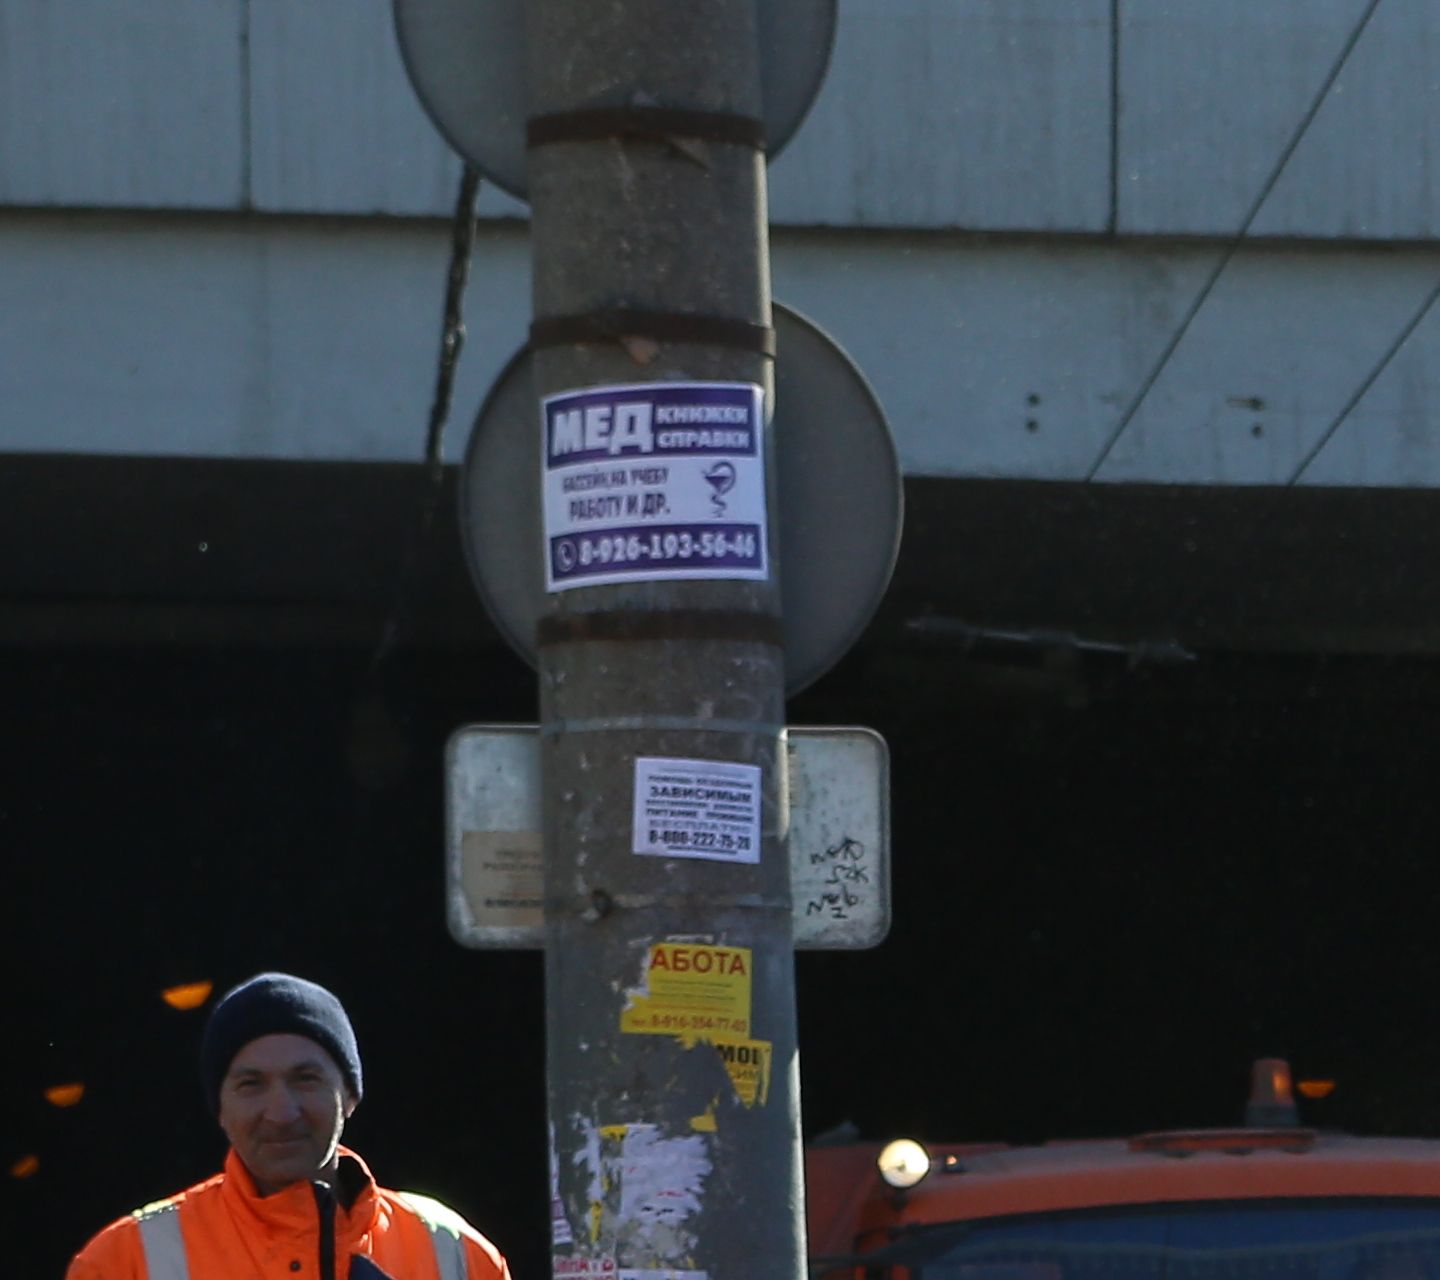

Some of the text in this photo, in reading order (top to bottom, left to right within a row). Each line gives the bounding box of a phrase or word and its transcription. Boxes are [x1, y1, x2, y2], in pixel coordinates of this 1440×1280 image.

[553, 403, 654, 456] МЕД
[658, 431, 750, 449] СПРАВКИ
[570, 496, 622, 520] РАБОТУ
[650, 947, 747, 976] АБОТА
